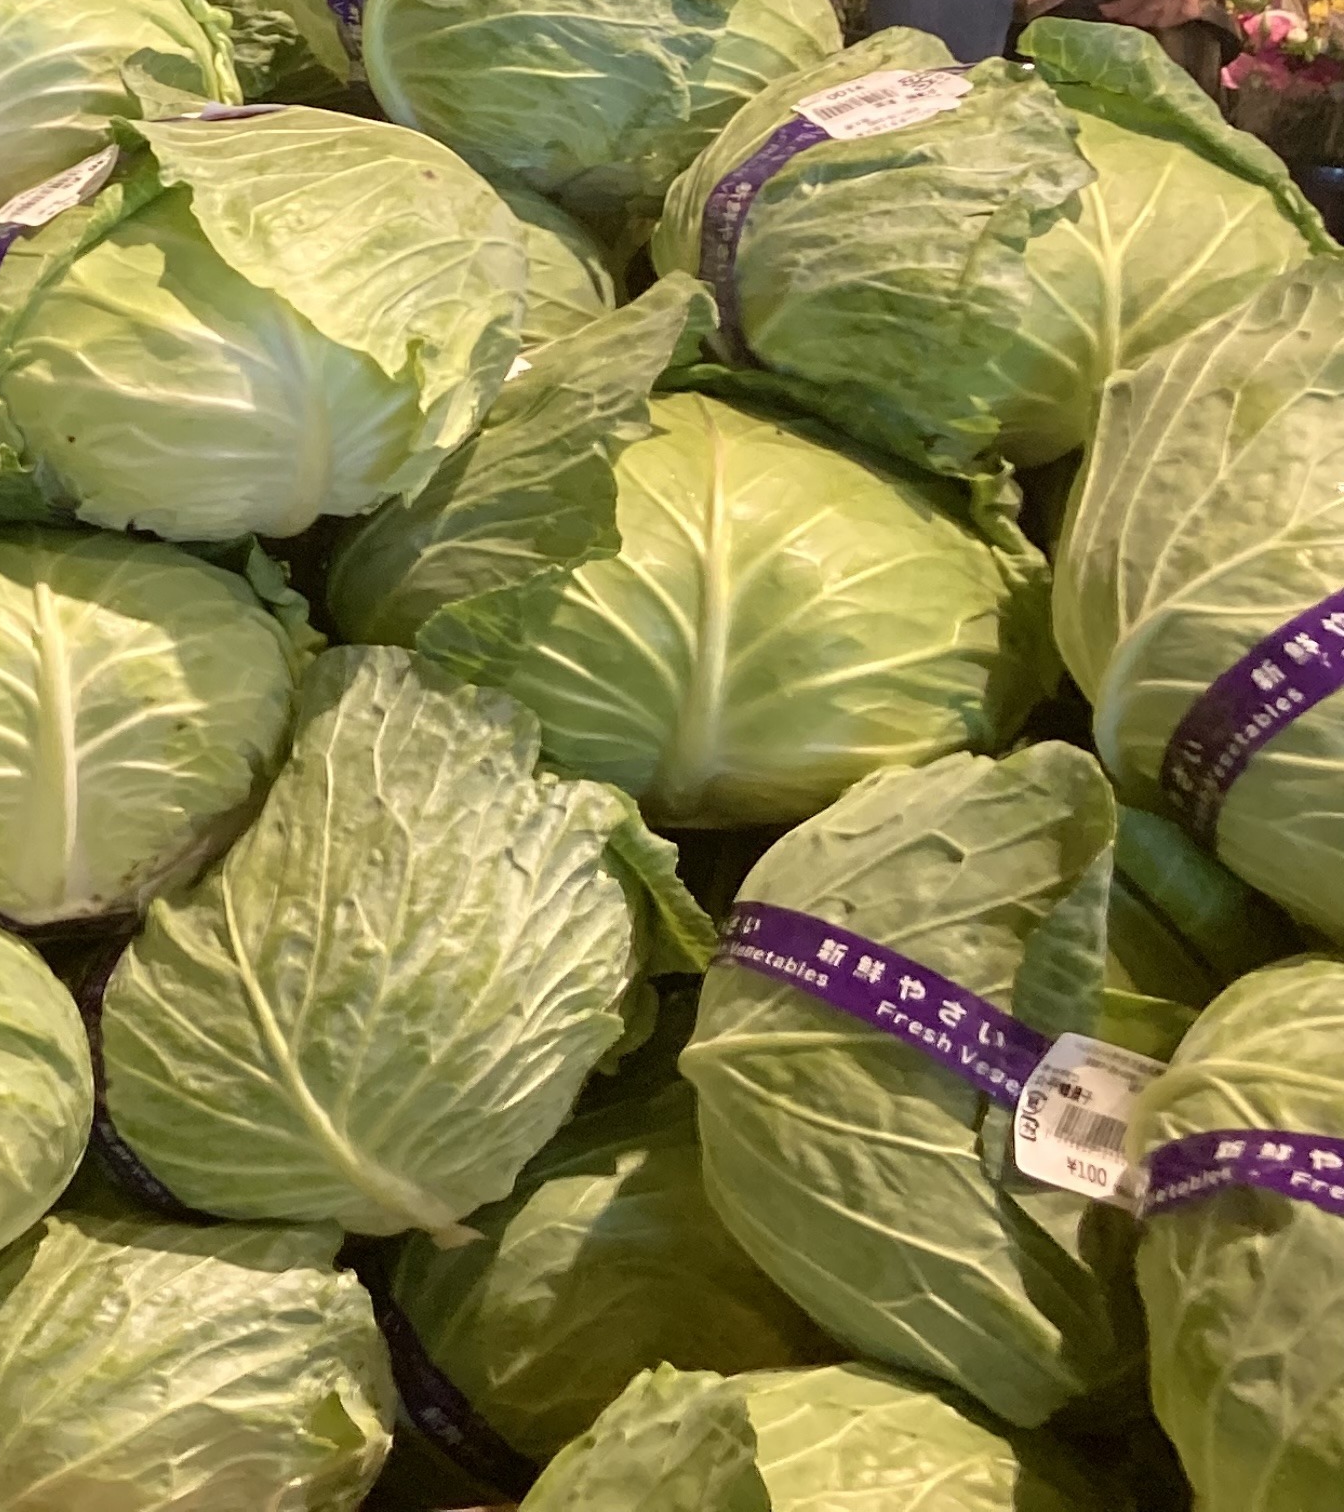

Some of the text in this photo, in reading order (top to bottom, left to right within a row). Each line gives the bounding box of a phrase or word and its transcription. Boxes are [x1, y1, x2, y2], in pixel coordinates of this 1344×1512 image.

[815, 936, 1007, 1050] 新鮮やさい
[874, 1000, 952, 1054] Fresh
[1064, 1154, 1109, 1190] ¥100
